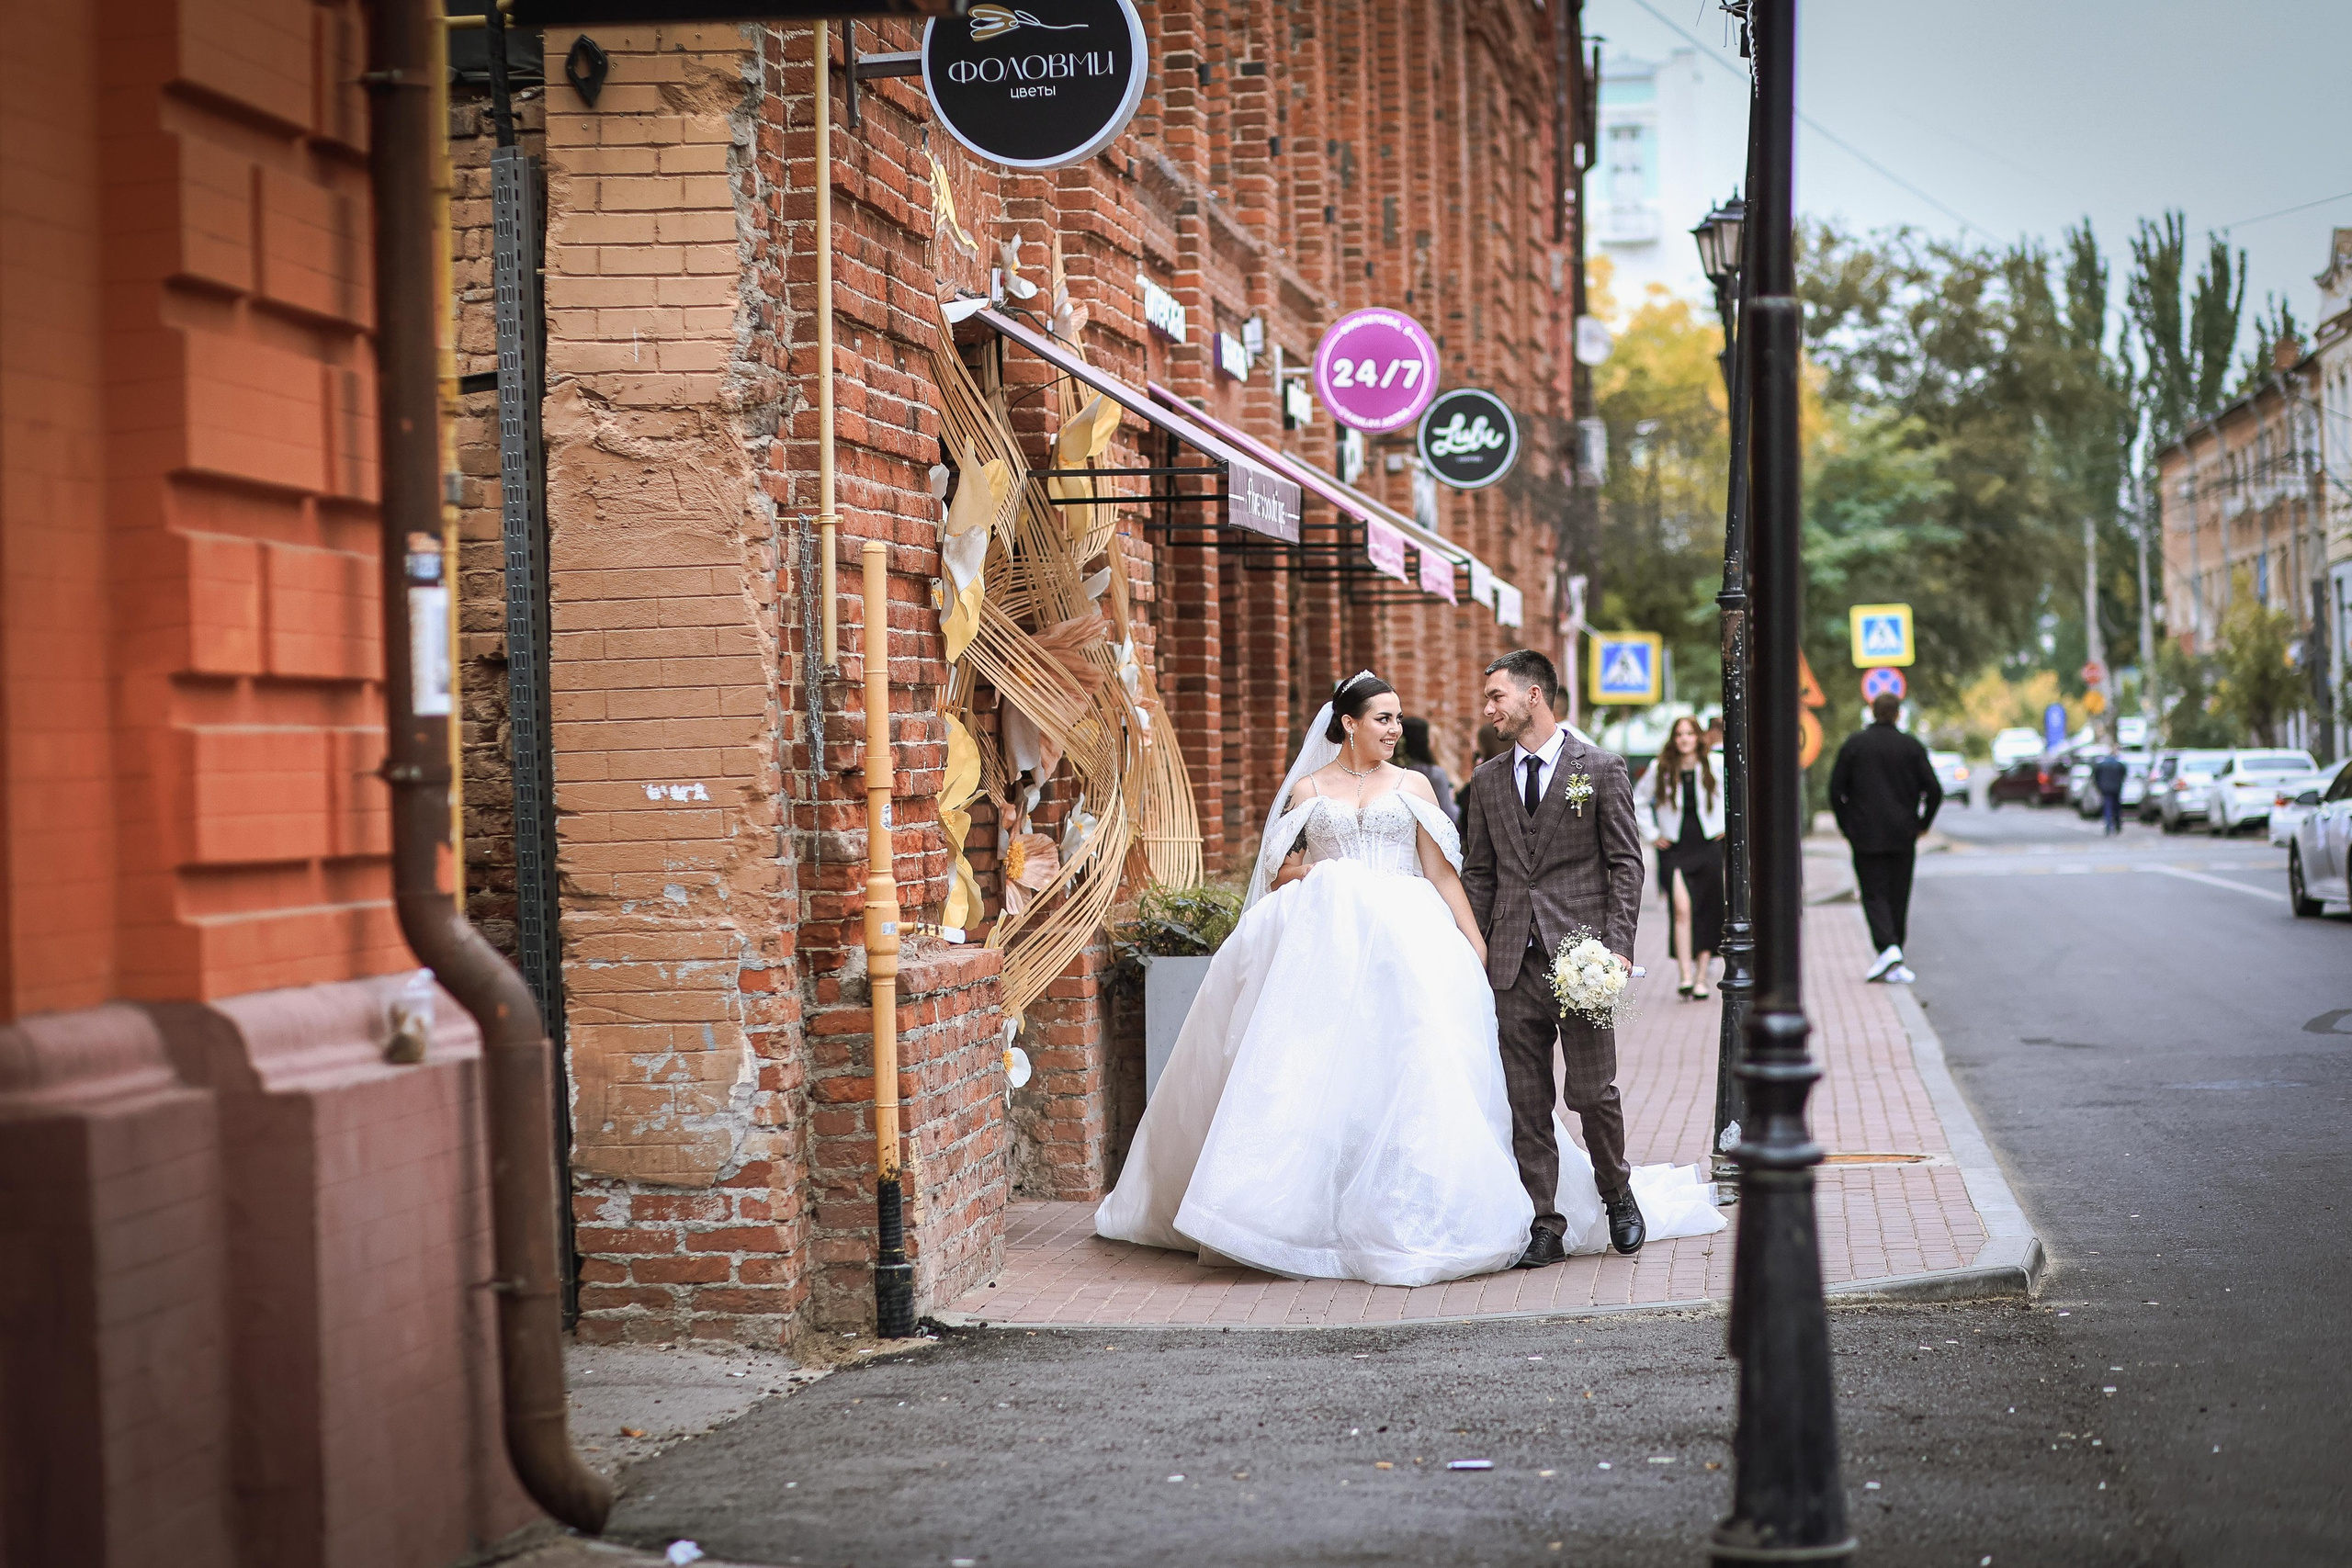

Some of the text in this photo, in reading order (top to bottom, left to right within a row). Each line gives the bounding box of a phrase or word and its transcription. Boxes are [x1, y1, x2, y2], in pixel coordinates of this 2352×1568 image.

[948, 51, 1114, 84] ФОЛОВМИ
[1010, 85, 1057, 98] цветы
[1331, 357, 1422, 389] 24/7
